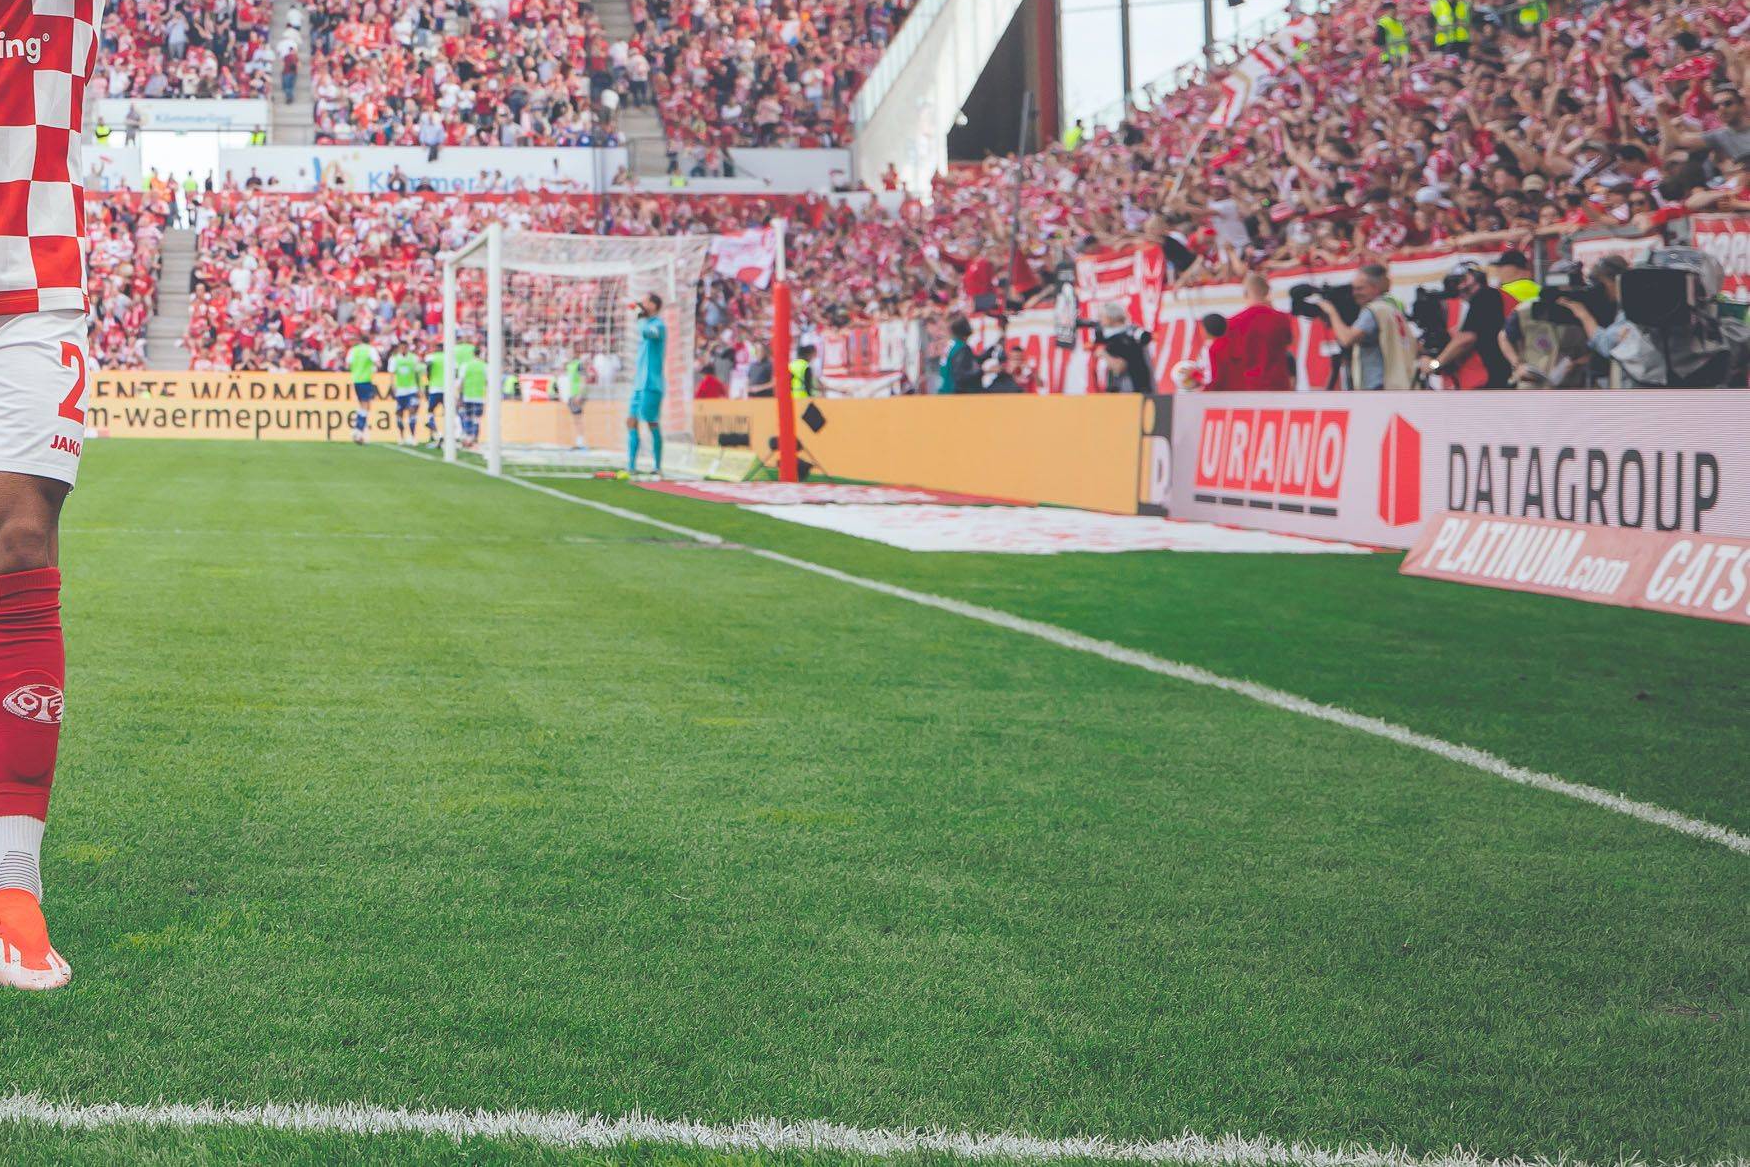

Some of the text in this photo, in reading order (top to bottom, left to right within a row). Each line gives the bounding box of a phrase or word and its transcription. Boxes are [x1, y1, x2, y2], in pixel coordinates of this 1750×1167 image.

[58, 340, 86, 425] 2
[50, 435, 81, 458] JAKO
[1200, 418, 1343, 489] URANO
[1448, 443, 1720, 532] DATAGROUP
[1421, 517, 1750, 612] PLATINUM.com CATS
